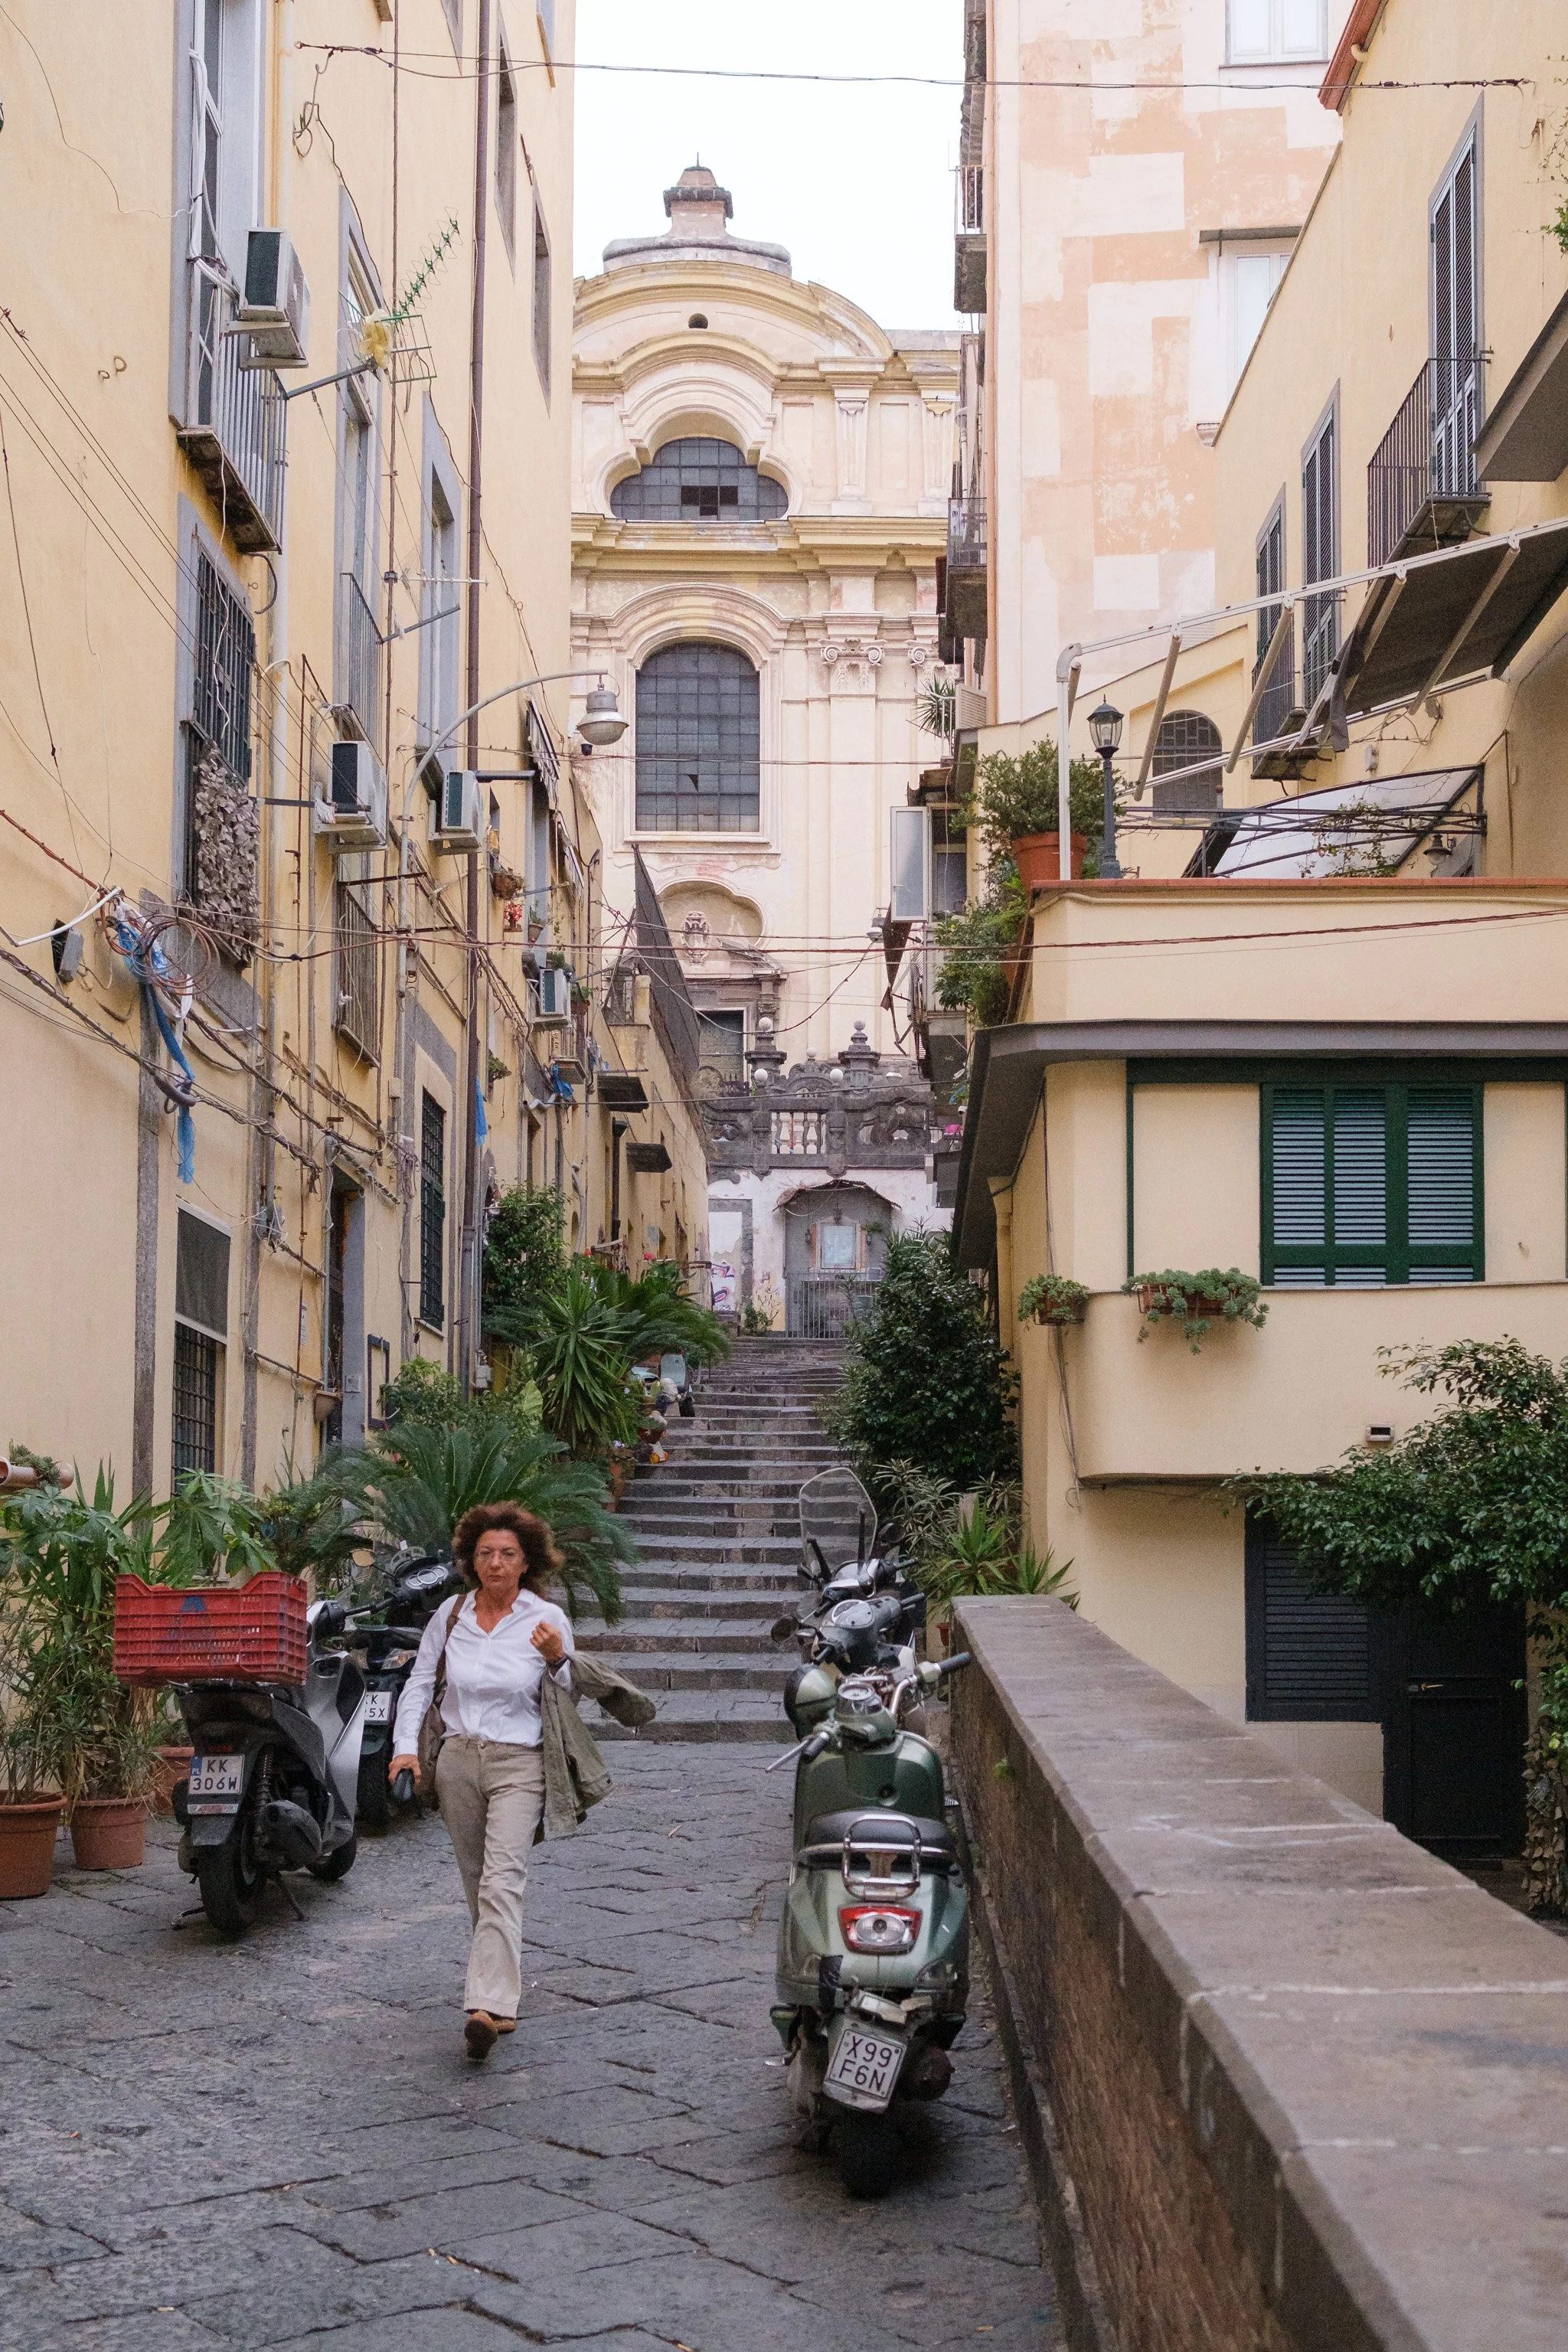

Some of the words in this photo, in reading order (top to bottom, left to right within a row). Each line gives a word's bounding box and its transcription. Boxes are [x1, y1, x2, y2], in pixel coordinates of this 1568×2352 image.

[206, 1759, 228, 1773] KK
[193, 1776, 237, 1791] 306W
[847, 2036, 893, 2068] X99
[838, 2059, 886, 2092] F6N
